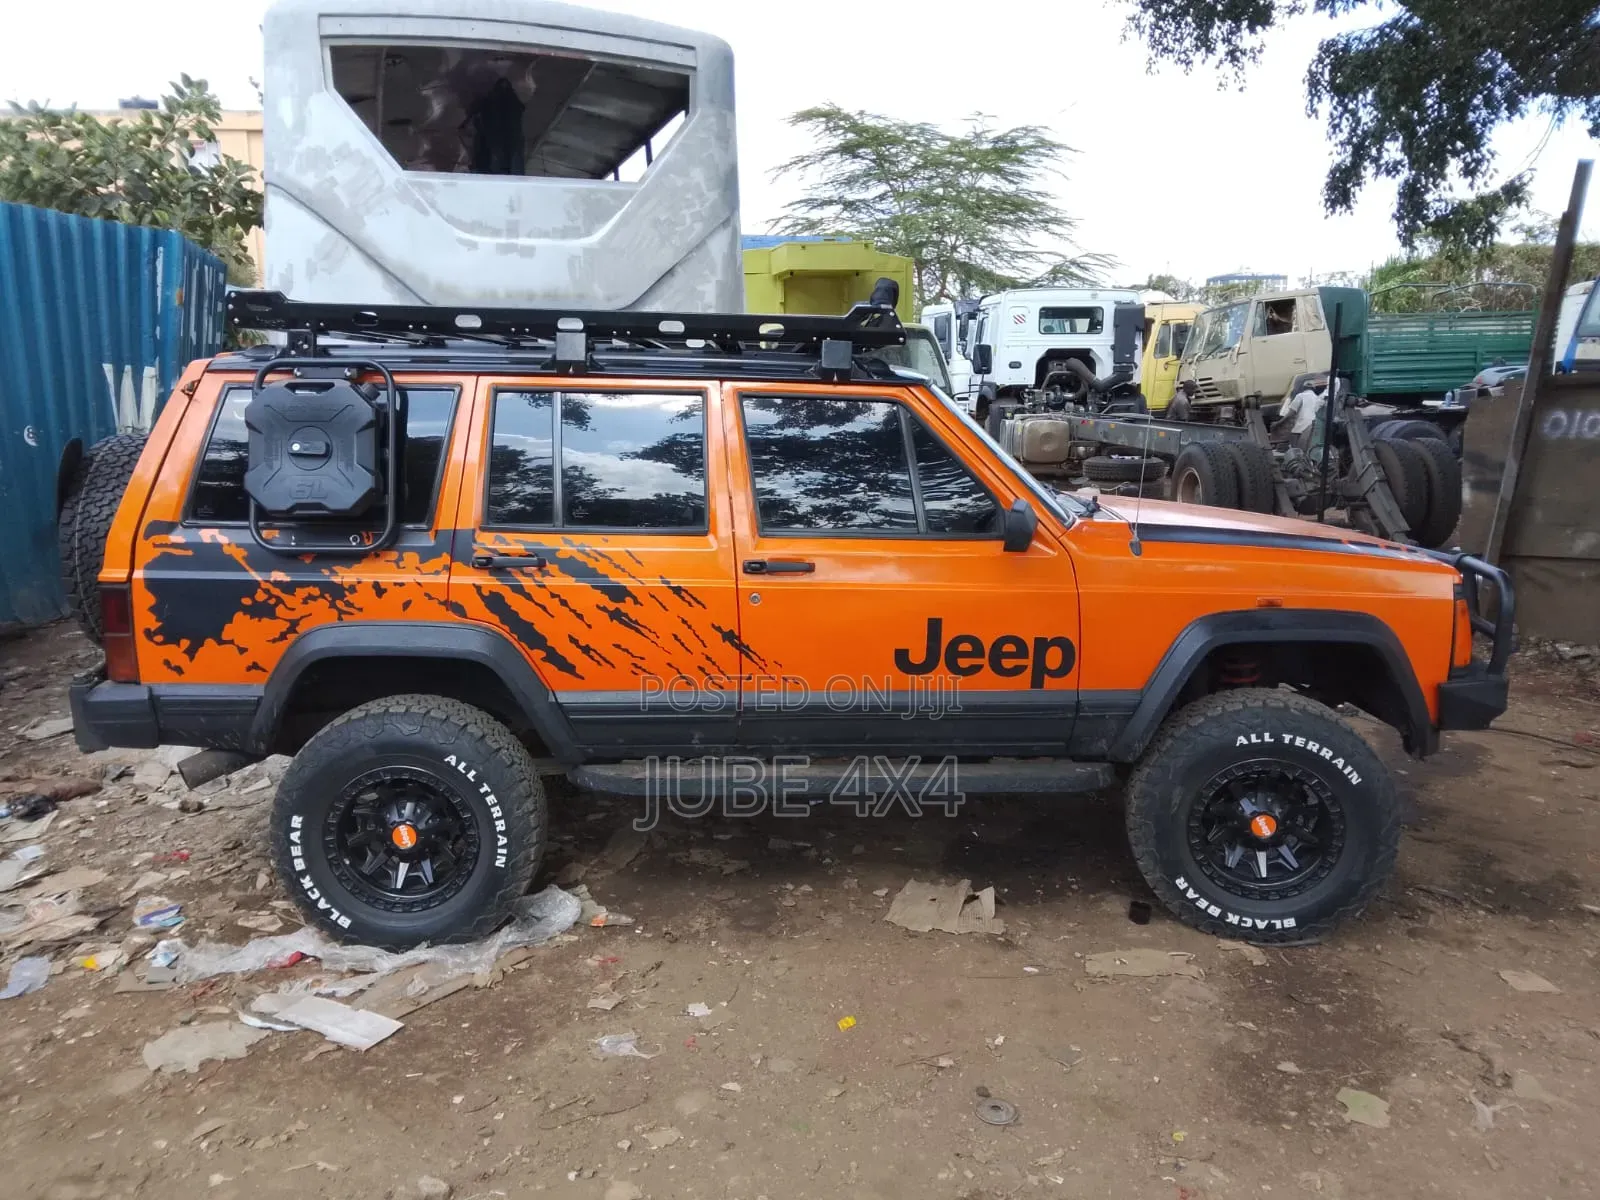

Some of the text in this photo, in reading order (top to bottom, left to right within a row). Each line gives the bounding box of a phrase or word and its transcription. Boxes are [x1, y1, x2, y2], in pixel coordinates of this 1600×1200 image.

[894, 617, 1077, 689] Jeep
[1235, 732, 1363, 786] ALL TERRAIN
[444, 754, 508, 868] ALL TERRAIN
[290, 815, 352, 929] BLACK BEAR
[1175, 876, 1297, 930] BLACK BEAR
